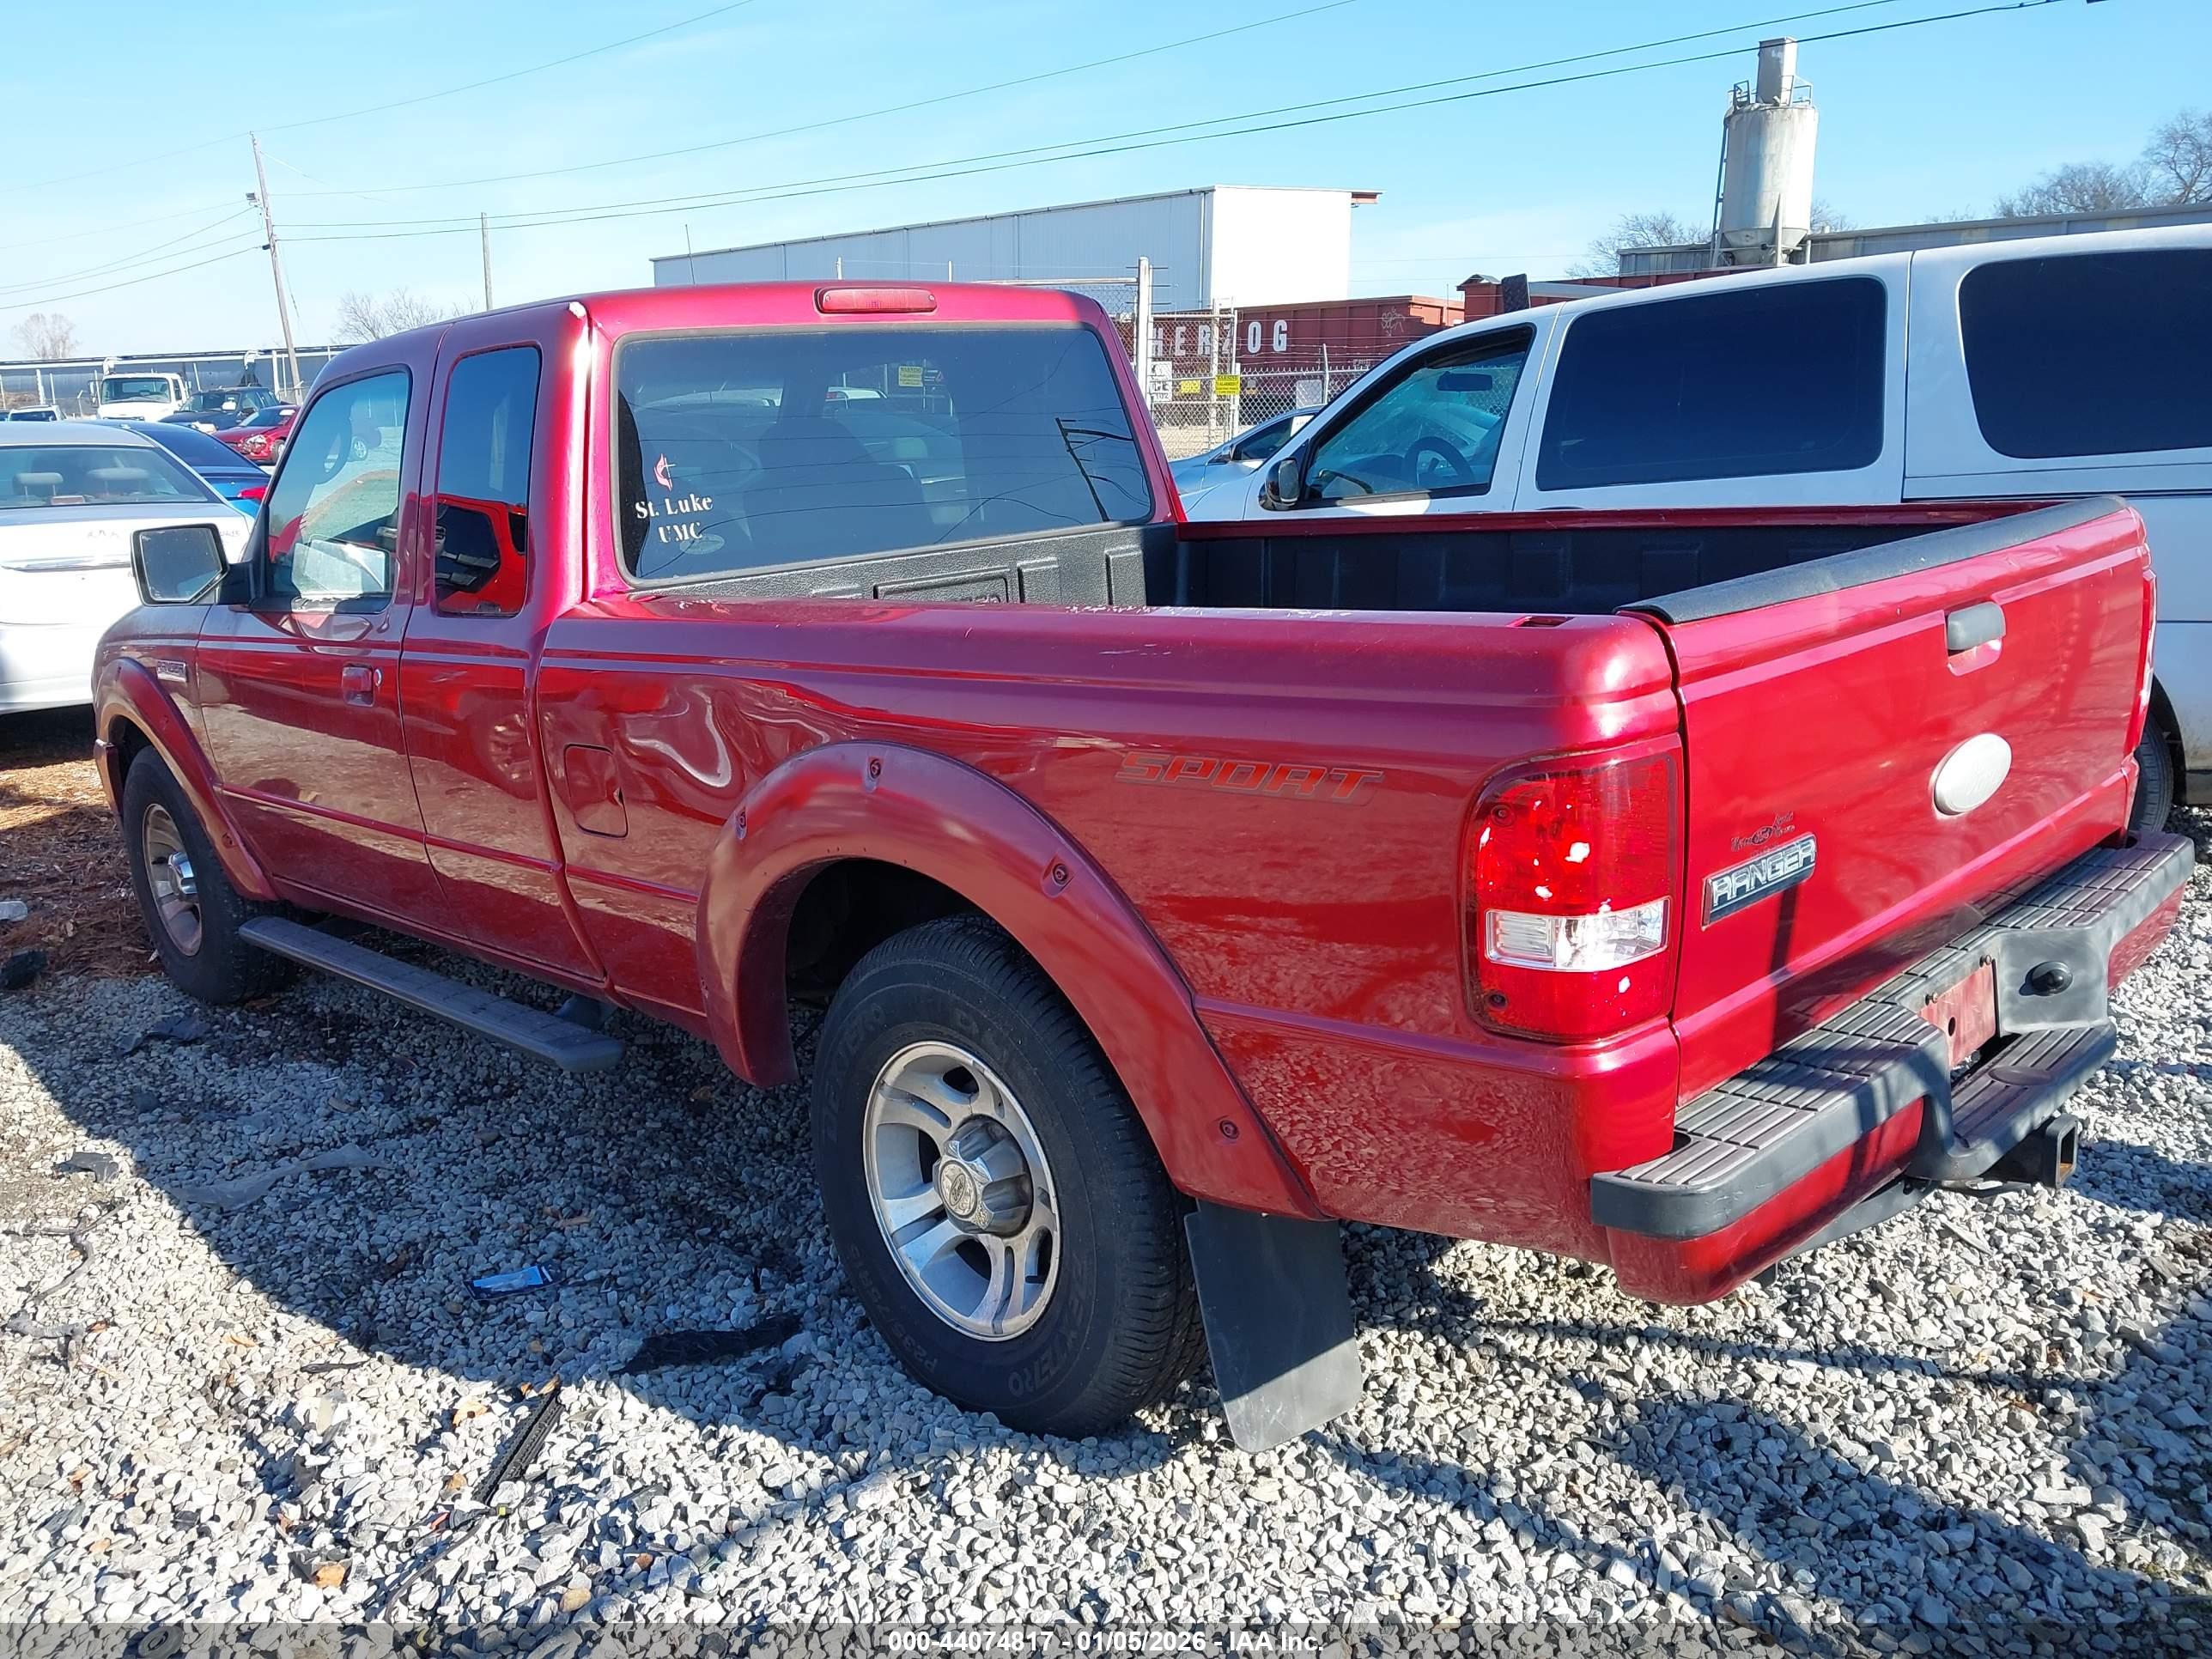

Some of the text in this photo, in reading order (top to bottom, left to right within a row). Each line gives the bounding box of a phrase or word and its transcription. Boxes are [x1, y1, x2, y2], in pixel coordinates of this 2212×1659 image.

[1152, 319, 1288, 357] HERZOG
[635, 493, 714, 519] St. Luke
[658, 522, 702, 544] UMC
[1115, 751, 1383, 800] SPORT
[1712, 838, 1816, 907] RANGER
